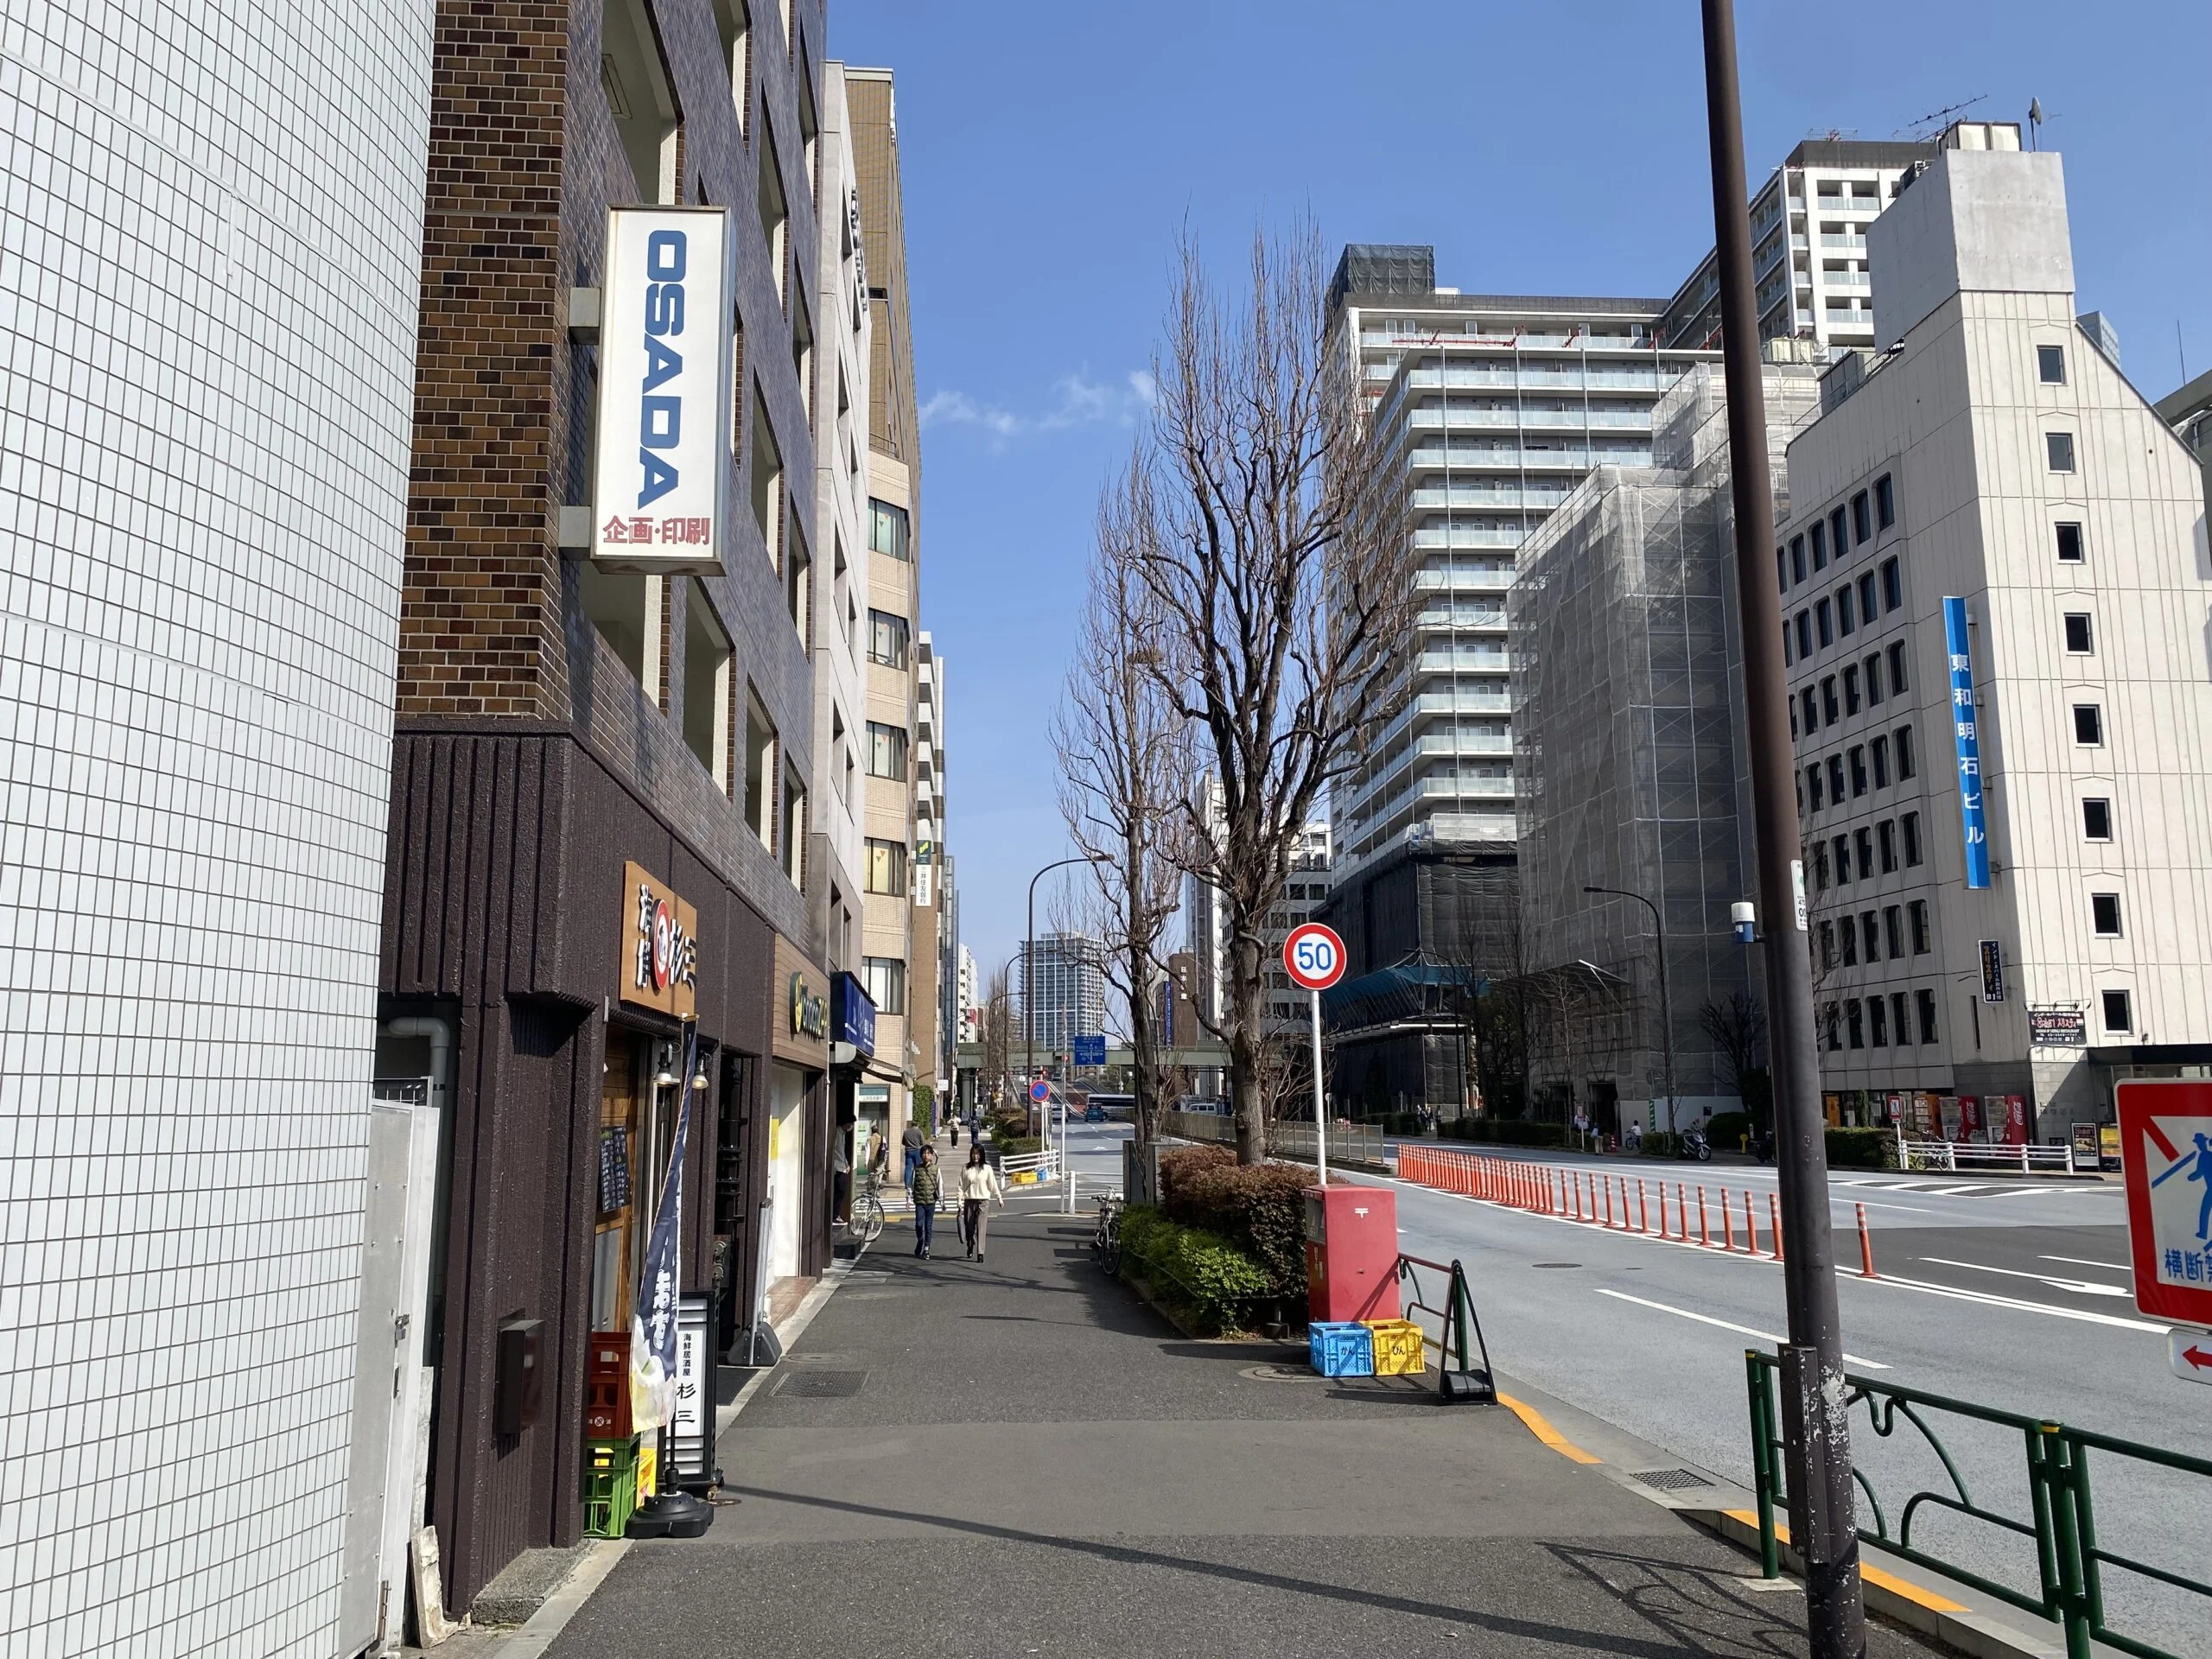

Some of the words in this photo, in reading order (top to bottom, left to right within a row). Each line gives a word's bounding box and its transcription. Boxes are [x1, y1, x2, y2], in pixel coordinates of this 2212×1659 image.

[638, 230, 687, 510] OSADA
[1951, 654, 1985, 844] 東和明石ビル
[1299, 943, 1332, 970] 50
[682, 1333, 691, 1376] 海鮮居酒屋
[1340, 1345, 1355, 1356] かん
[1392, 1345, 1406, 1356] びん
[676, 1382, 696, 1423] 杉三
